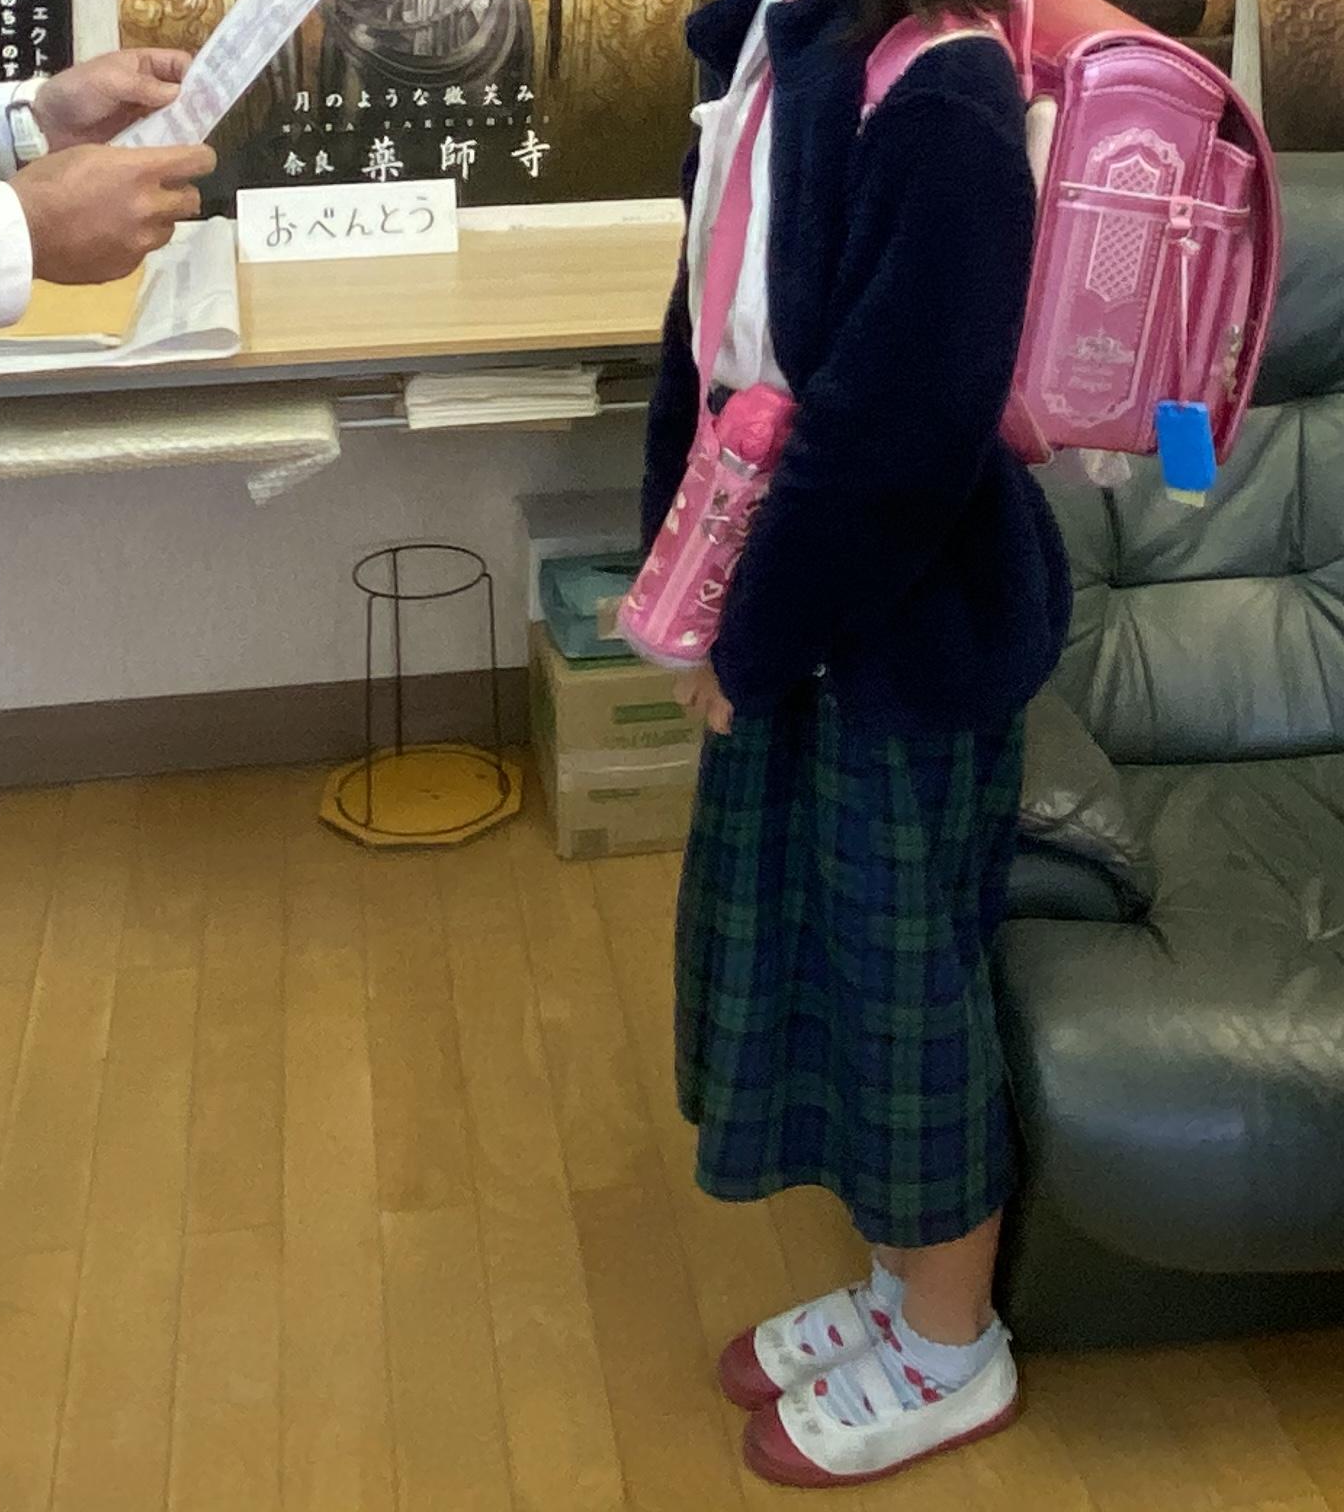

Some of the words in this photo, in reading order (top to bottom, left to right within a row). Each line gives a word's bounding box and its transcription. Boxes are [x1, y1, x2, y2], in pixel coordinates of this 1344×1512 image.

[293, 83, 535, 113] 月のような微笑み
[283, 149, 336, 177] 奈良
[360, 129, 552, 183] 薬師寺
[265, 195, 436, 248] おべんとう
